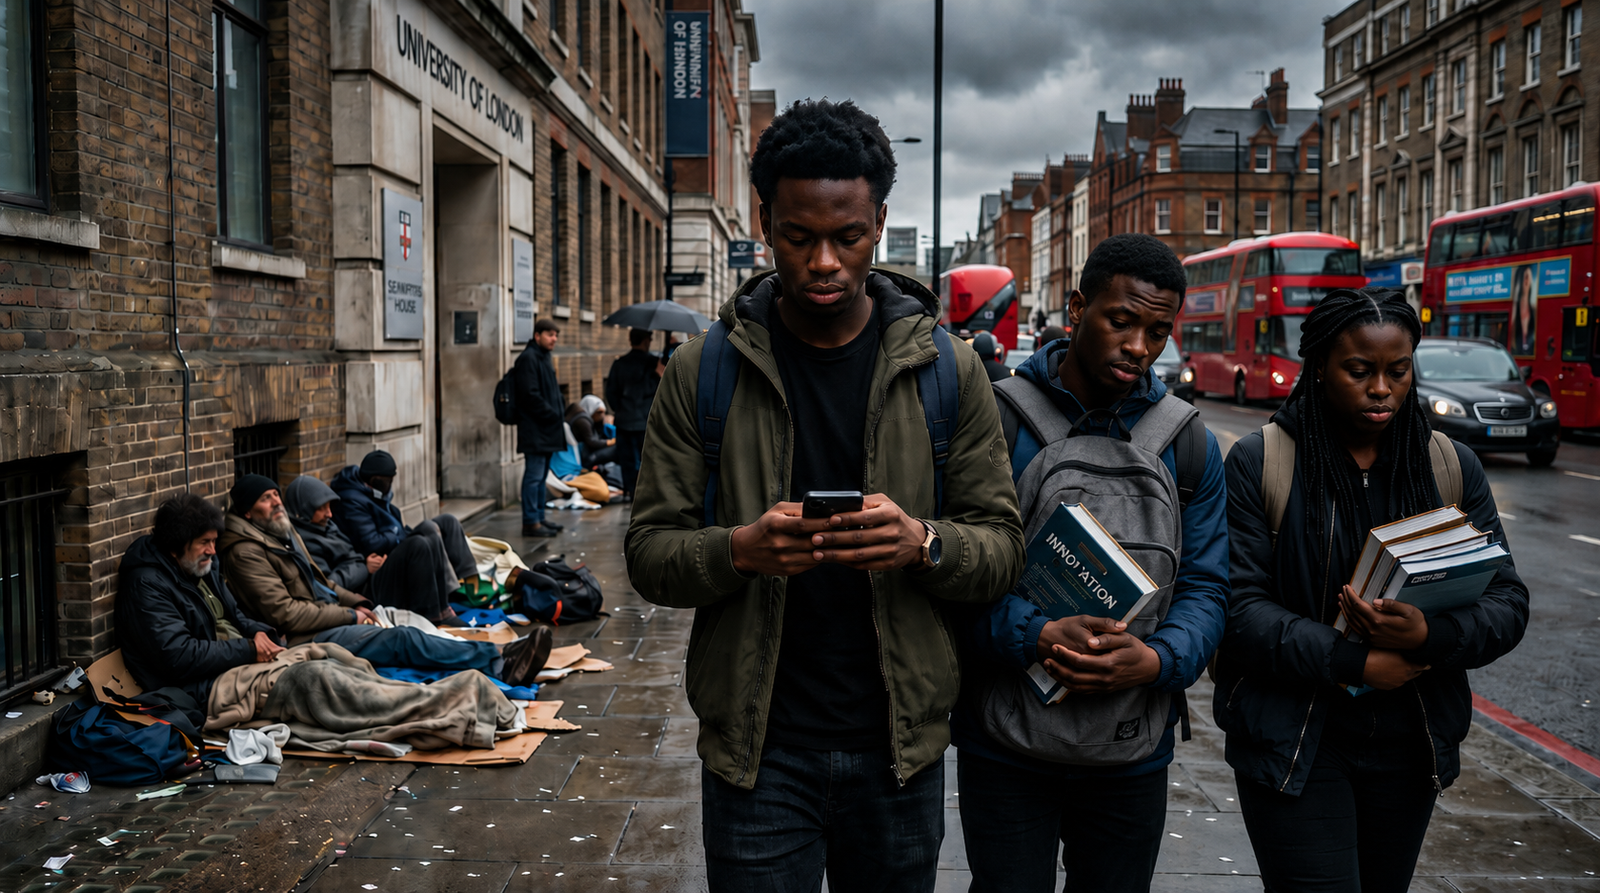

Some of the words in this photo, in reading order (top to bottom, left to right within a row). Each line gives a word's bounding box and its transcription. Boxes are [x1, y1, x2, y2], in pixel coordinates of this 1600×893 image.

[396, 14, 467, 100] UNIVERSITY
[469, 76, 484, 113] OF
[485, 87, 524, 143] LONDON
[394, 298, 416, 314] HOUSE
